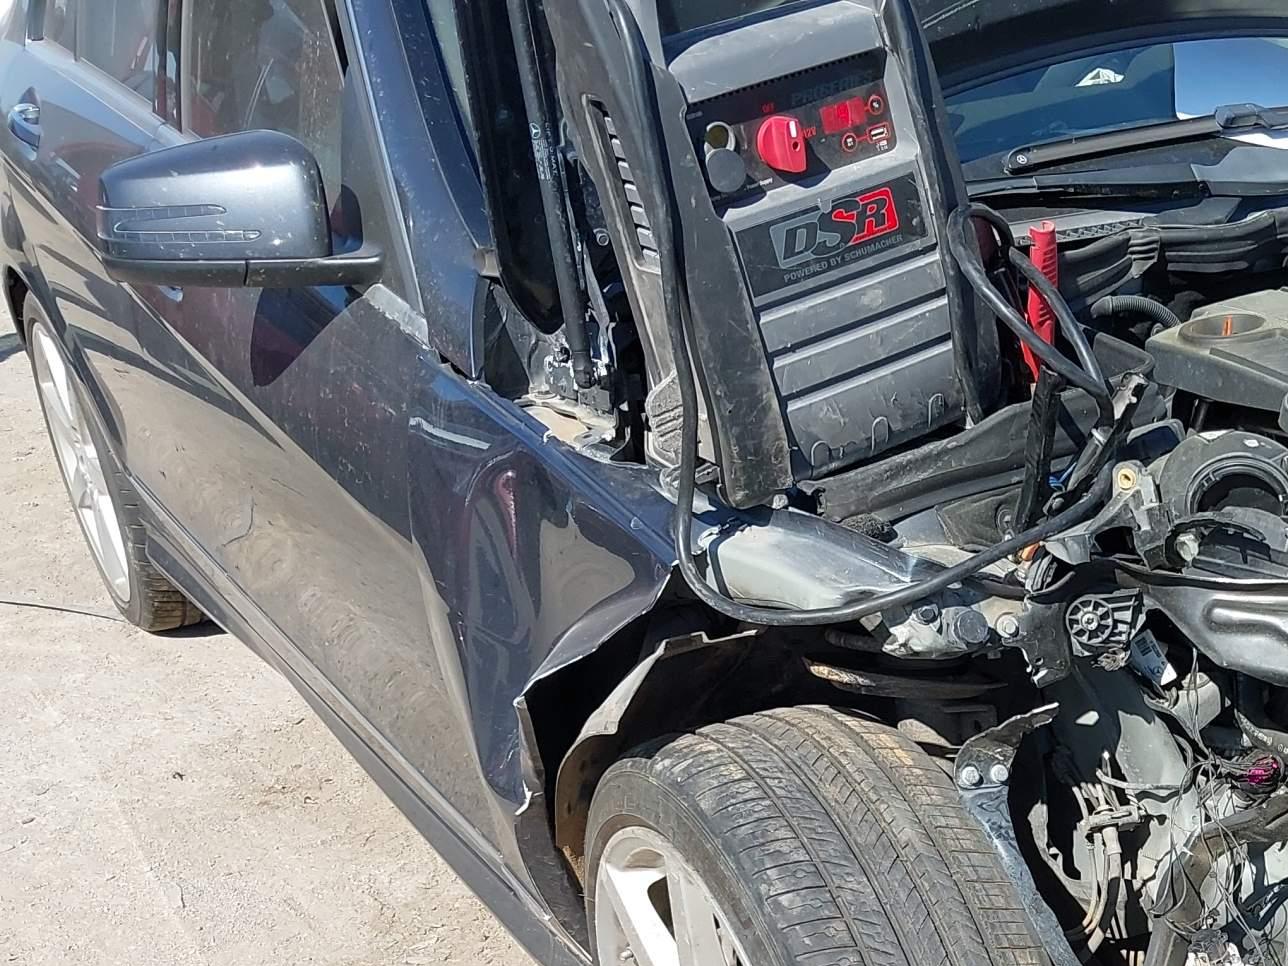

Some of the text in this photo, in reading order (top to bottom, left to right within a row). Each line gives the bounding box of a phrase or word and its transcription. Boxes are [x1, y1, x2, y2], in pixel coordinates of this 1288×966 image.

[782, 197, 889, 261] DSR
[783, 234, 904, 283] POWERED BY SCHUMACHER
